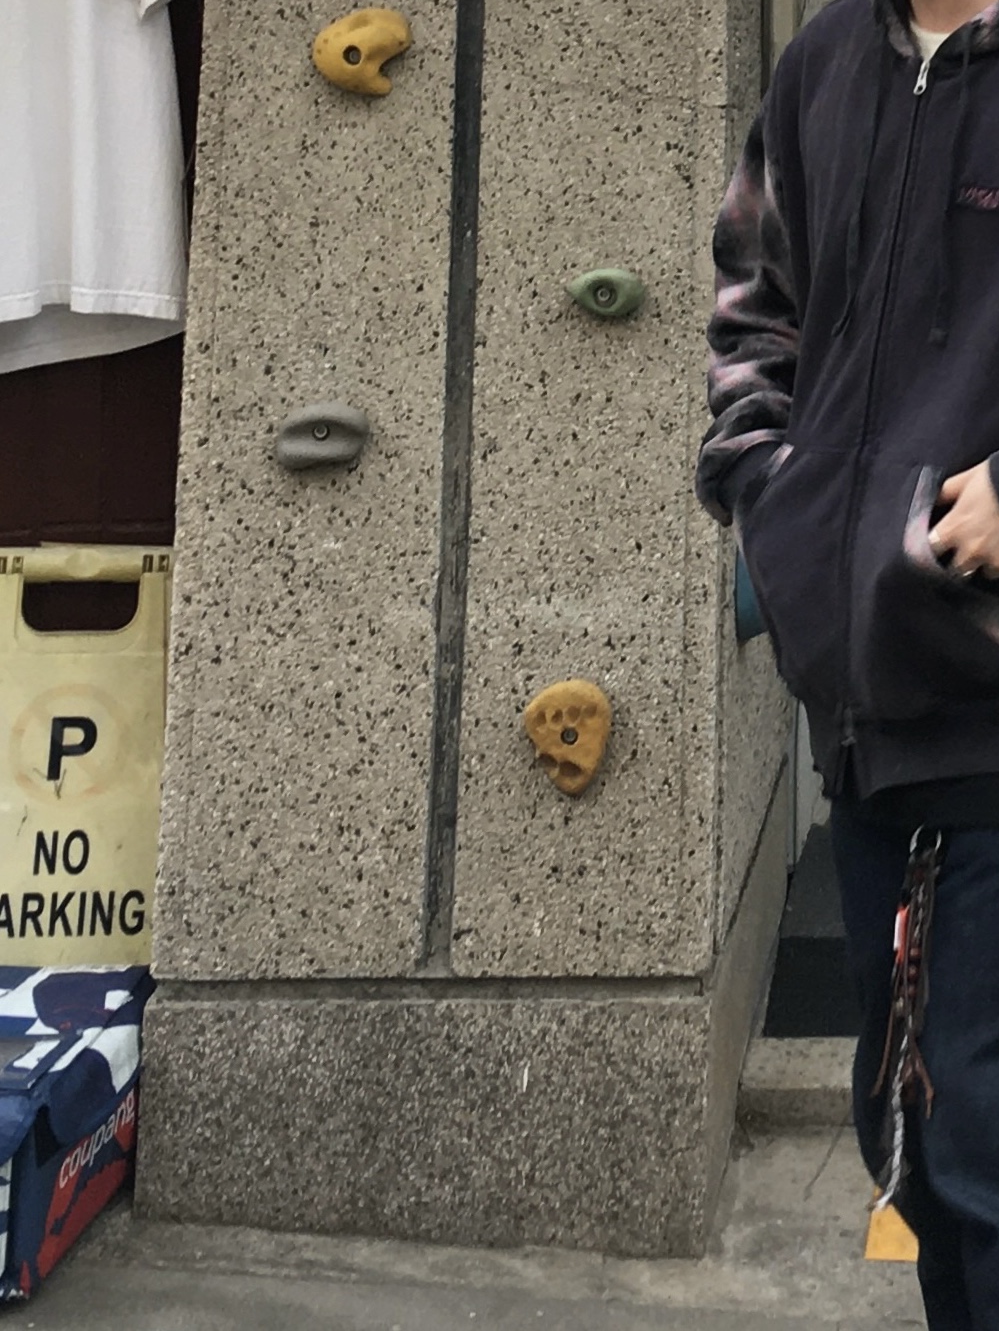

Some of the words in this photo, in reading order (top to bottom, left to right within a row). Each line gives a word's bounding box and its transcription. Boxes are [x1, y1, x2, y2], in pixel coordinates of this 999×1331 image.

[46, 716, 98, 782] P
[32, 829, 90, 876] NO
[0, 889, 146, 939] ARKING
[58, 1083, 137, 1189] coupang
